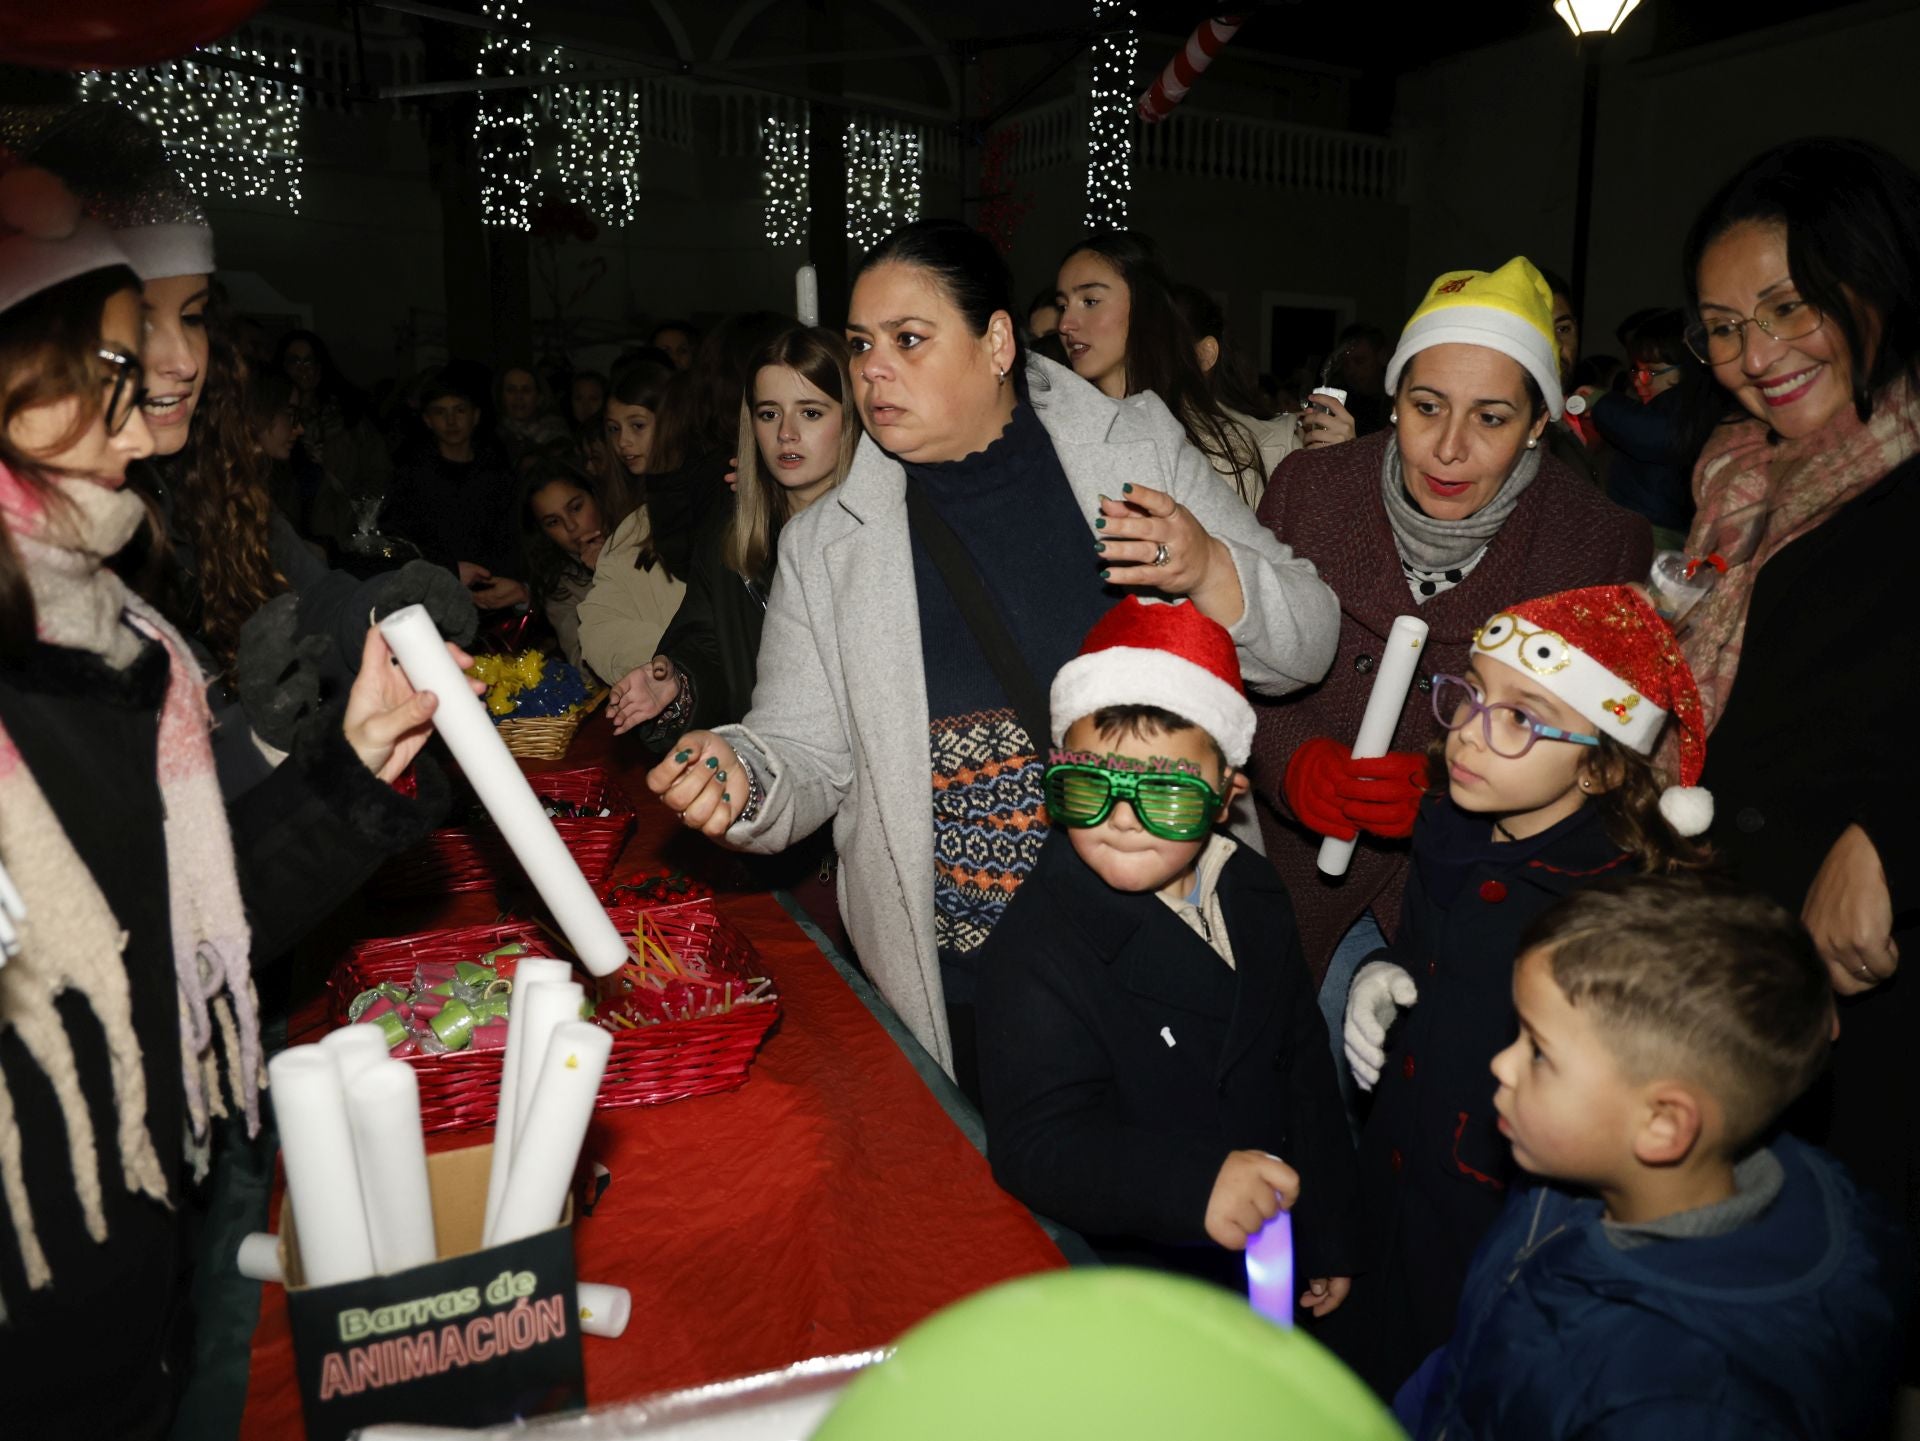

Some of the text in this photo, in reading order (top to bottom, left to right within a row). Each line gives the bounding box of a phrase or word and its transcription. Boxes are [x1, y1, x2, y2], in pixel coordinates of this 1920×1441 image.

[320, 1295, 566, 1400] ANIMACIÓN
[338, 1271, 537, 1342] Barras de
